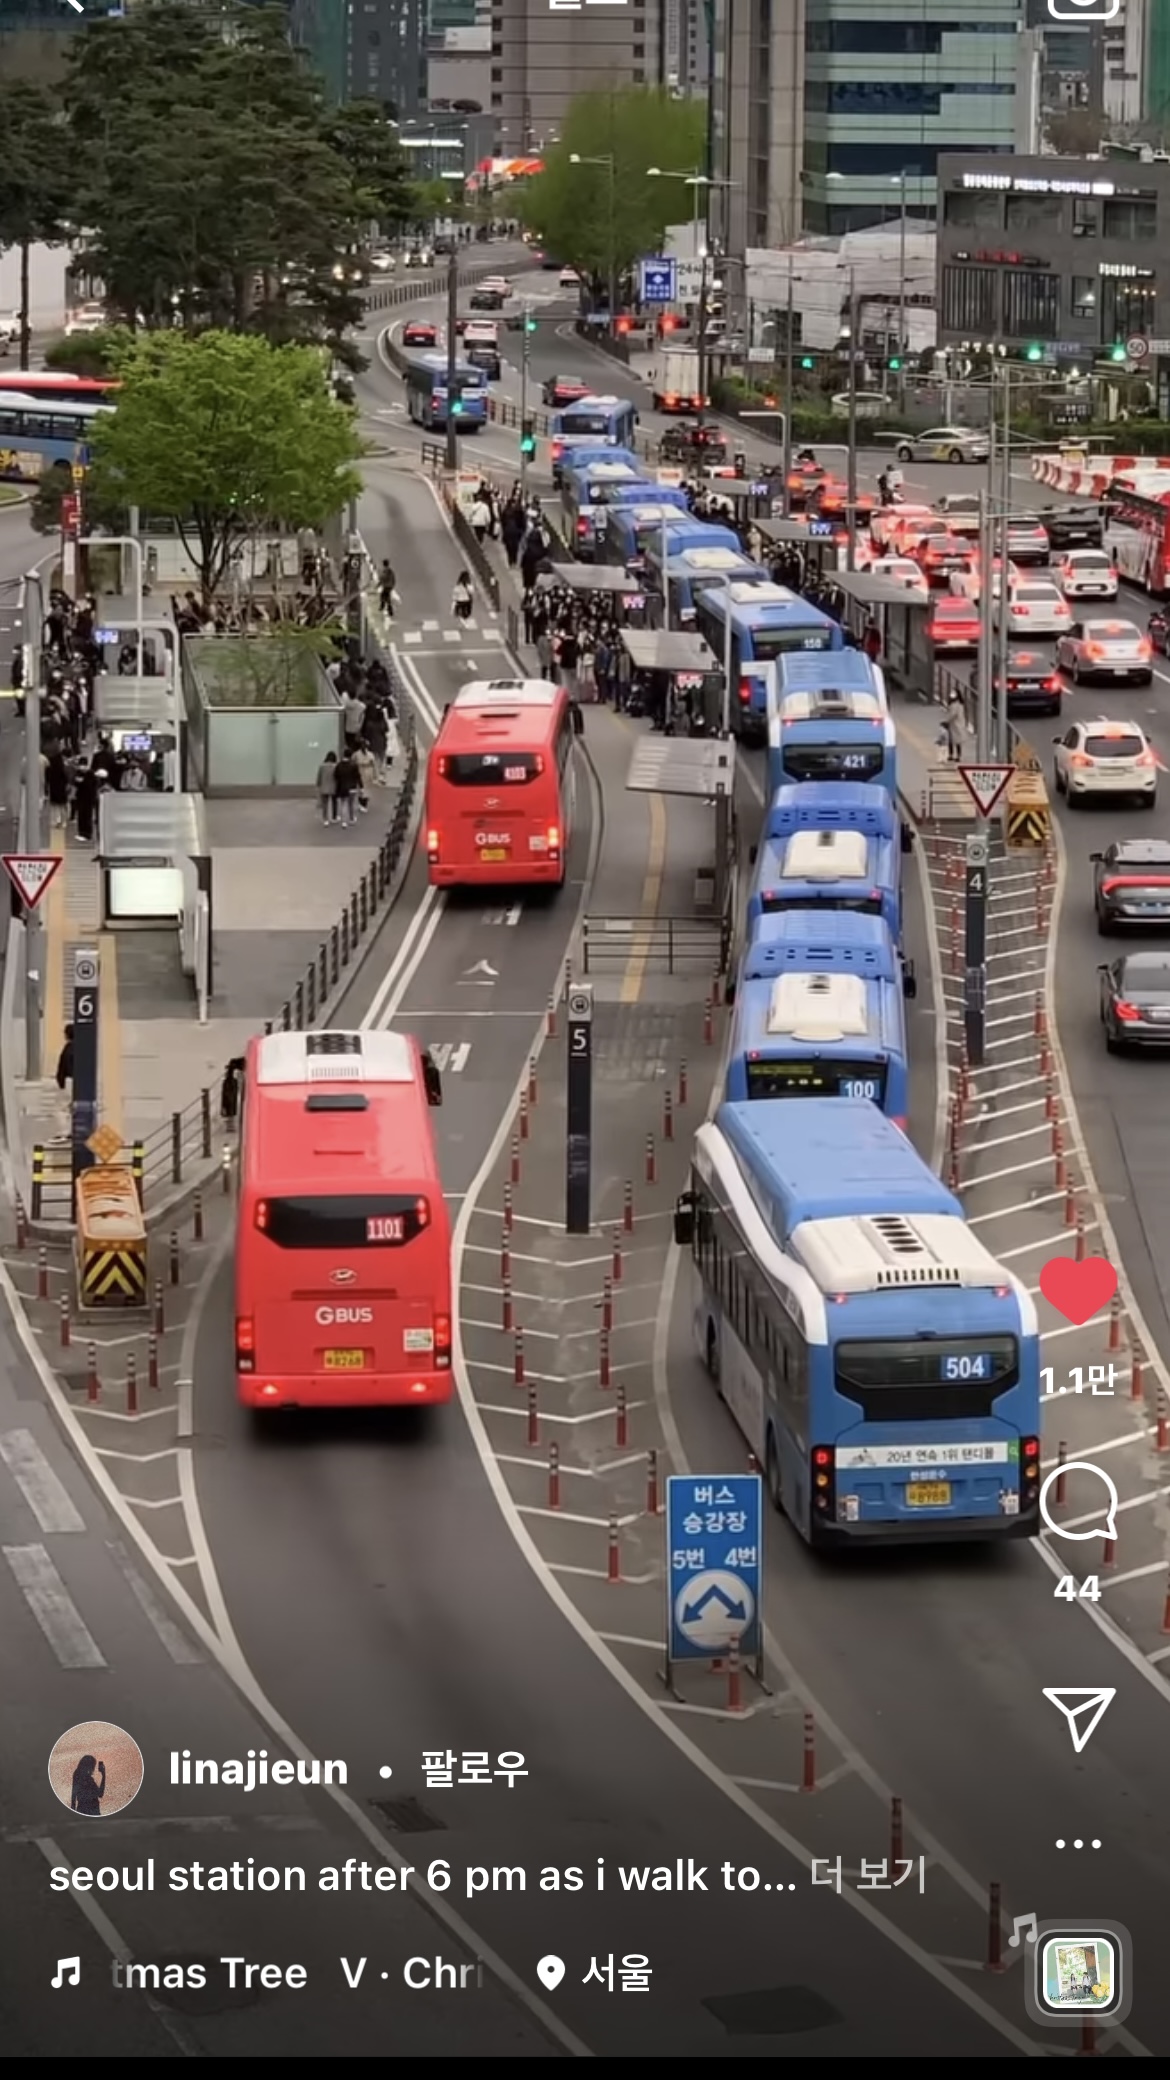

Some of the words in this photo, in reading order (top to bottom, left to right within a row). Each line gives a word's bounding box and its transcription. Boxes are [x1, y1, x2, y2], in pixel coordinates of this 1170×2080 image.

[1129, 342, 1143, 354] 50
[597, 531, 606, 544] 5
[843, 755, 866, 768] 421
[969, 872, 983, 891] 4
[77, 994, 93, 1017] 6
[572, 1028, 586, 1051] 5
[844, 1080, 876, 1099] 100
[367, 1217, 403, 1239] 1101
[946, 1355, 985, 1378] 504
[887, 1450, 912, 1465] 20년
[694, 1484, 737, 1506] 버스
[682, 1510, 748, 1535] 승강장
[672, 1547, 706, 1570] 5번
[724, 1545, 758, 1568] 4번
